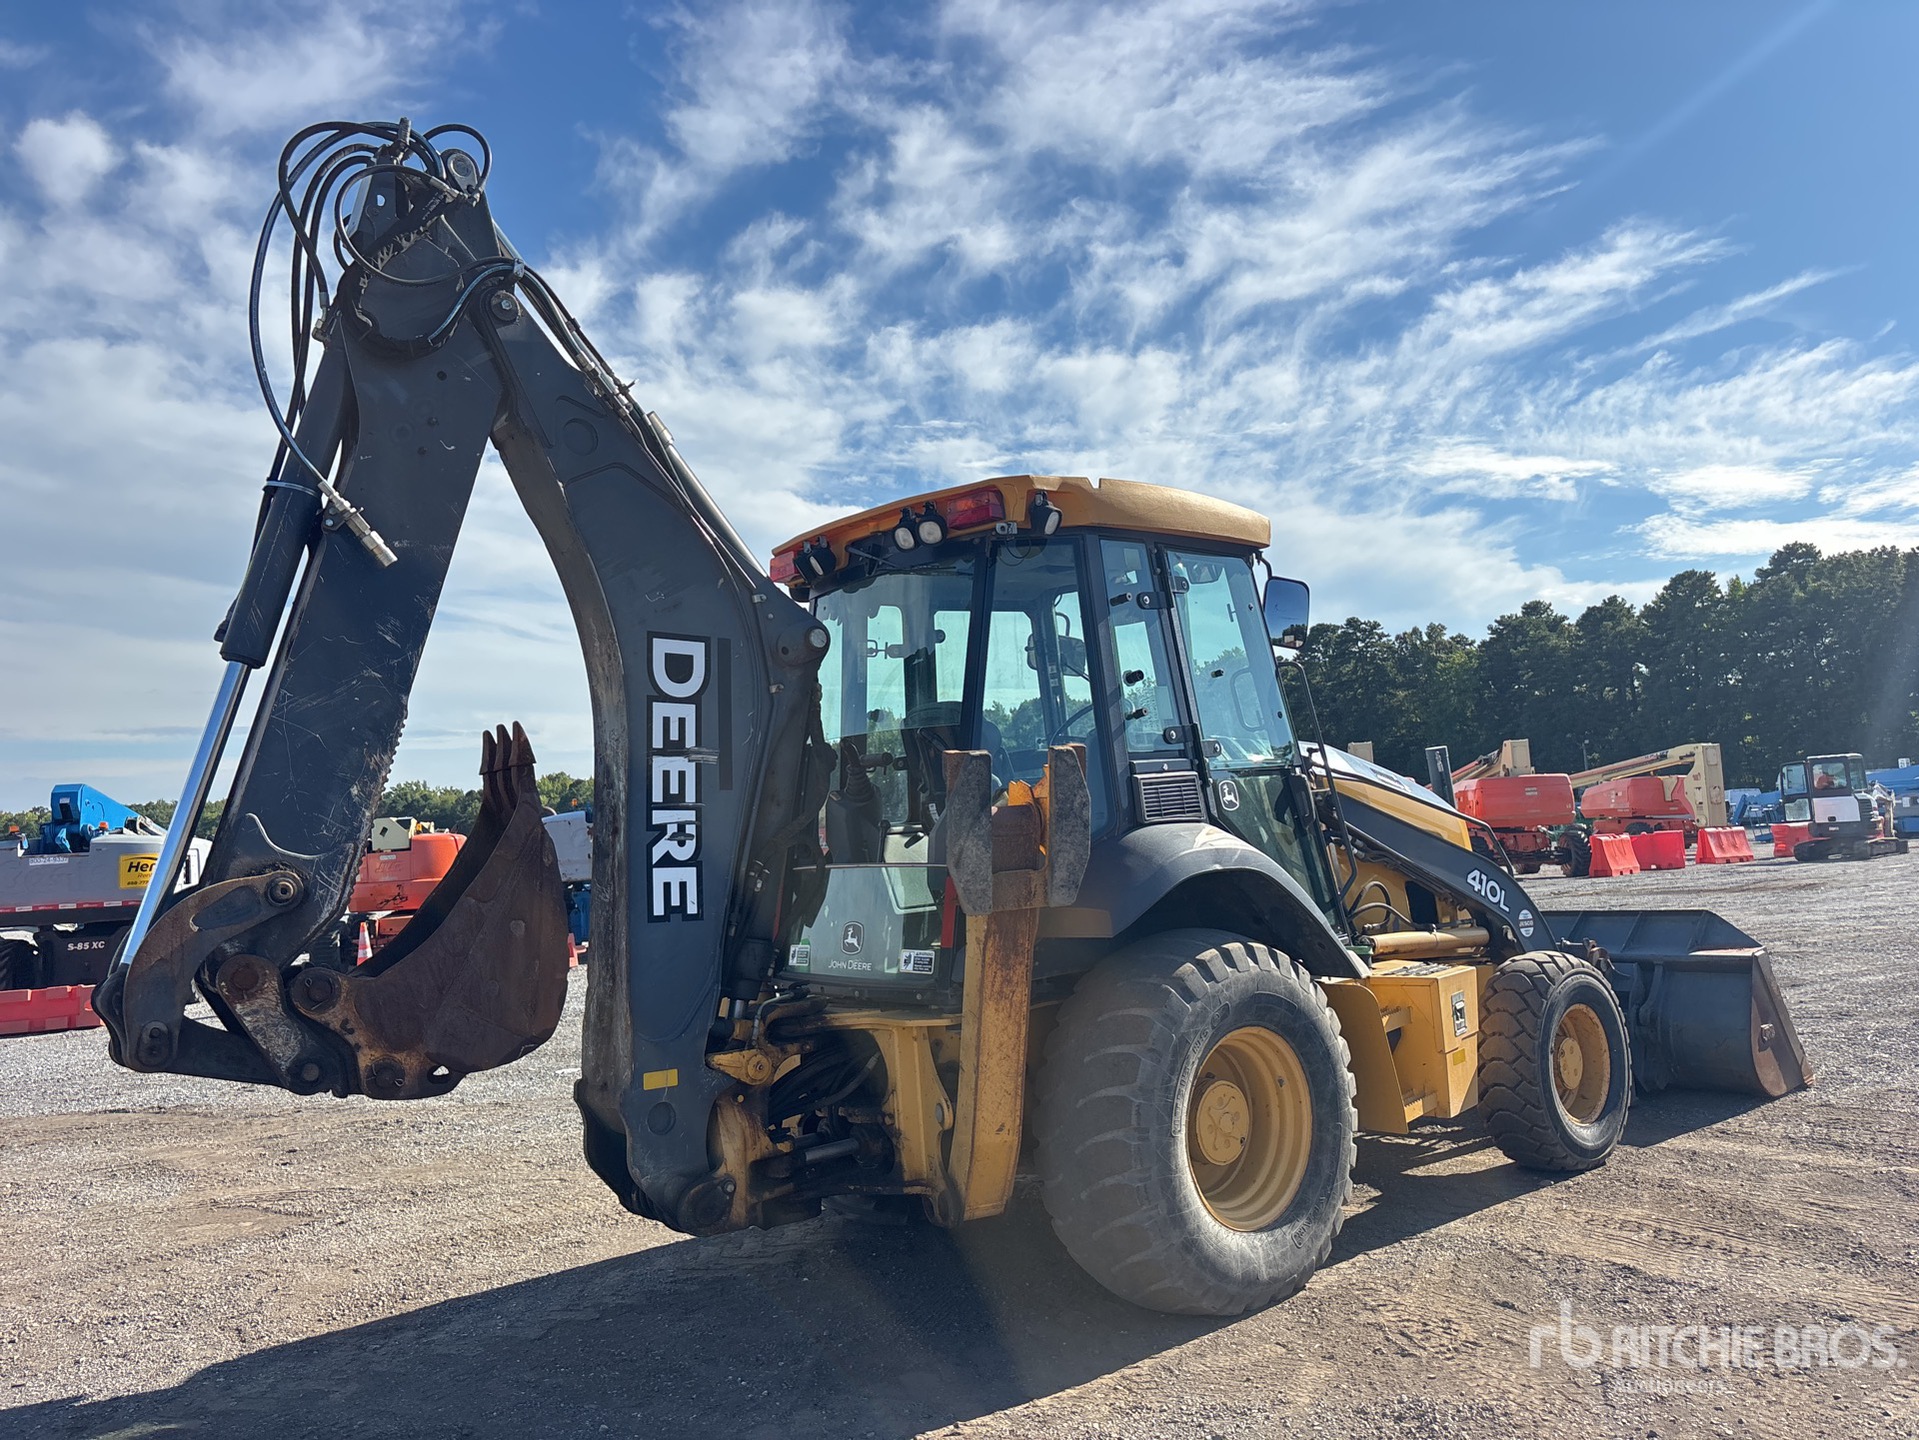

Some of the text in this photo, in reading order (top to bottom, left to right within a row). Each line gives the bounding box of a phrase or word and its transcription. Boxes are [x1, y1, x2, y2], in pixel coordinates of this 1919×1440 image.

[651, 637, 706, 917] DEERE
[1466, 869, 1511, 913] 410L
[67, 940, 105, 951] S-85 XC
[828, 959, 872, 971] JOHN DEERE
